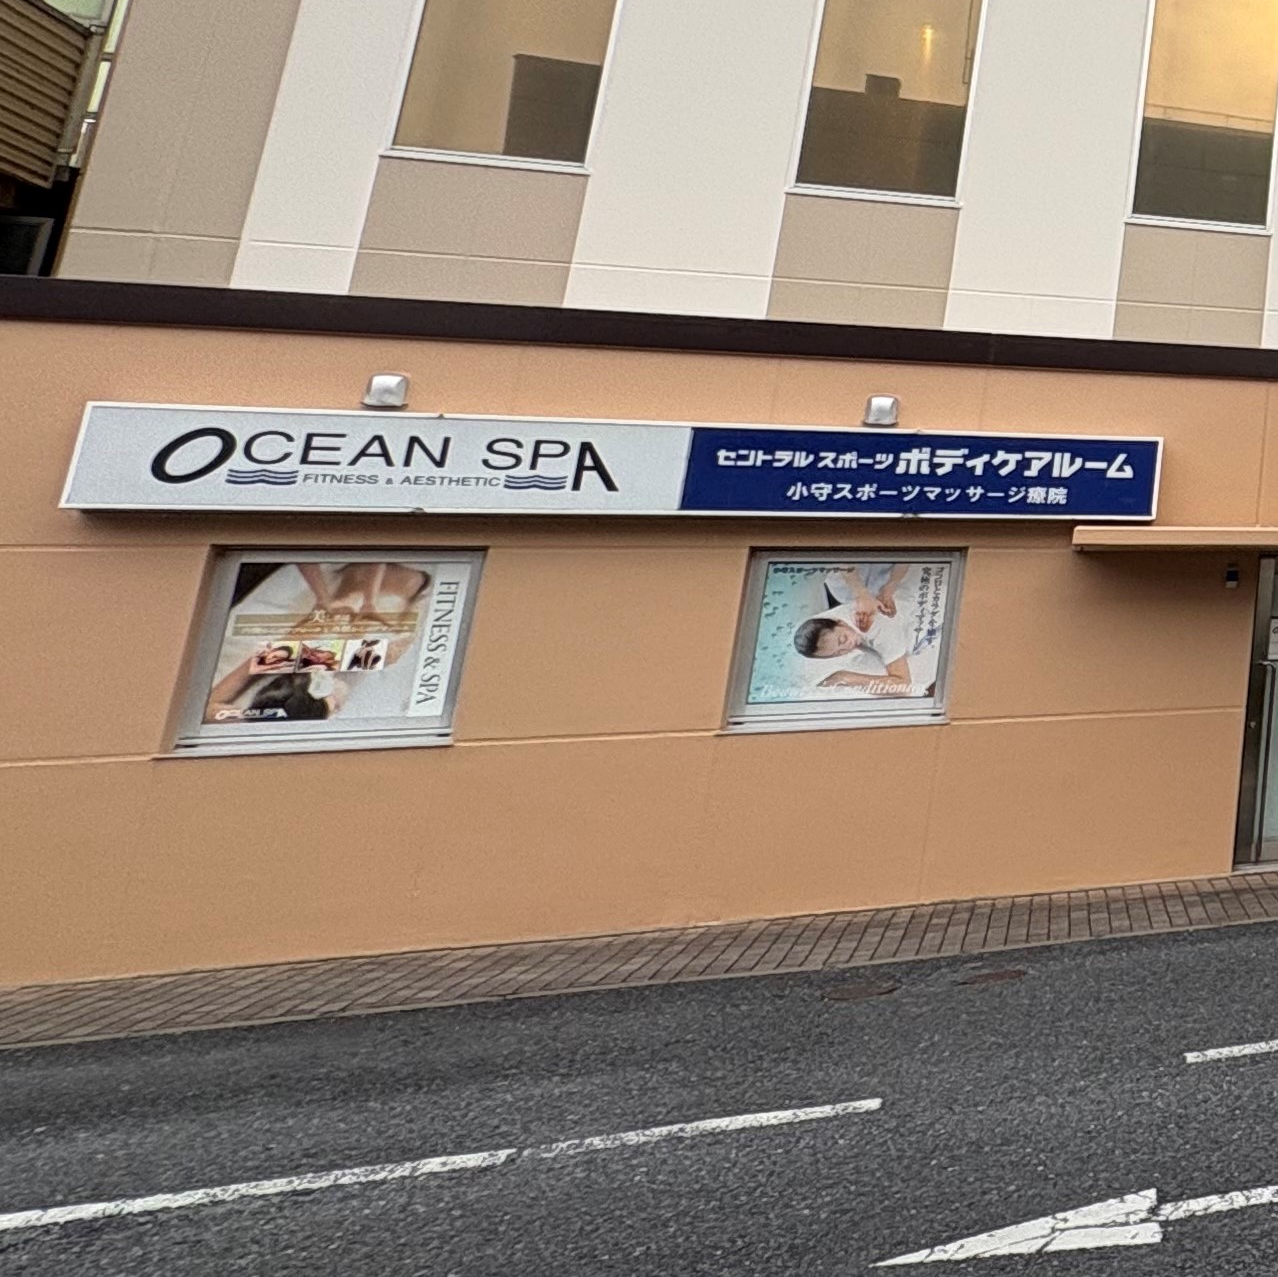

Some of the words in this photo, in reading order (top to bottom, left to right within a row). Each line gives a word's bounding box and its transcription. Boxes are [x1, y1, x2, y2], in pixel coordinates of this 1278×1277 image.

[150, 426, 452, 485] OCEAN
[481, 437, 620, 493] SPA
[302, 472, 380, 486] FITNESS
[384, 475, 394, 486] &
[400, 473, 501, 488] AESTHETIC
[785, 481, 1069, 506] 小守スポーツマッサージ療院
[426, 580, 461, 654] FITNESS
[425, 656, 442, 671] &
[415, 671, 442, 706] SPA
